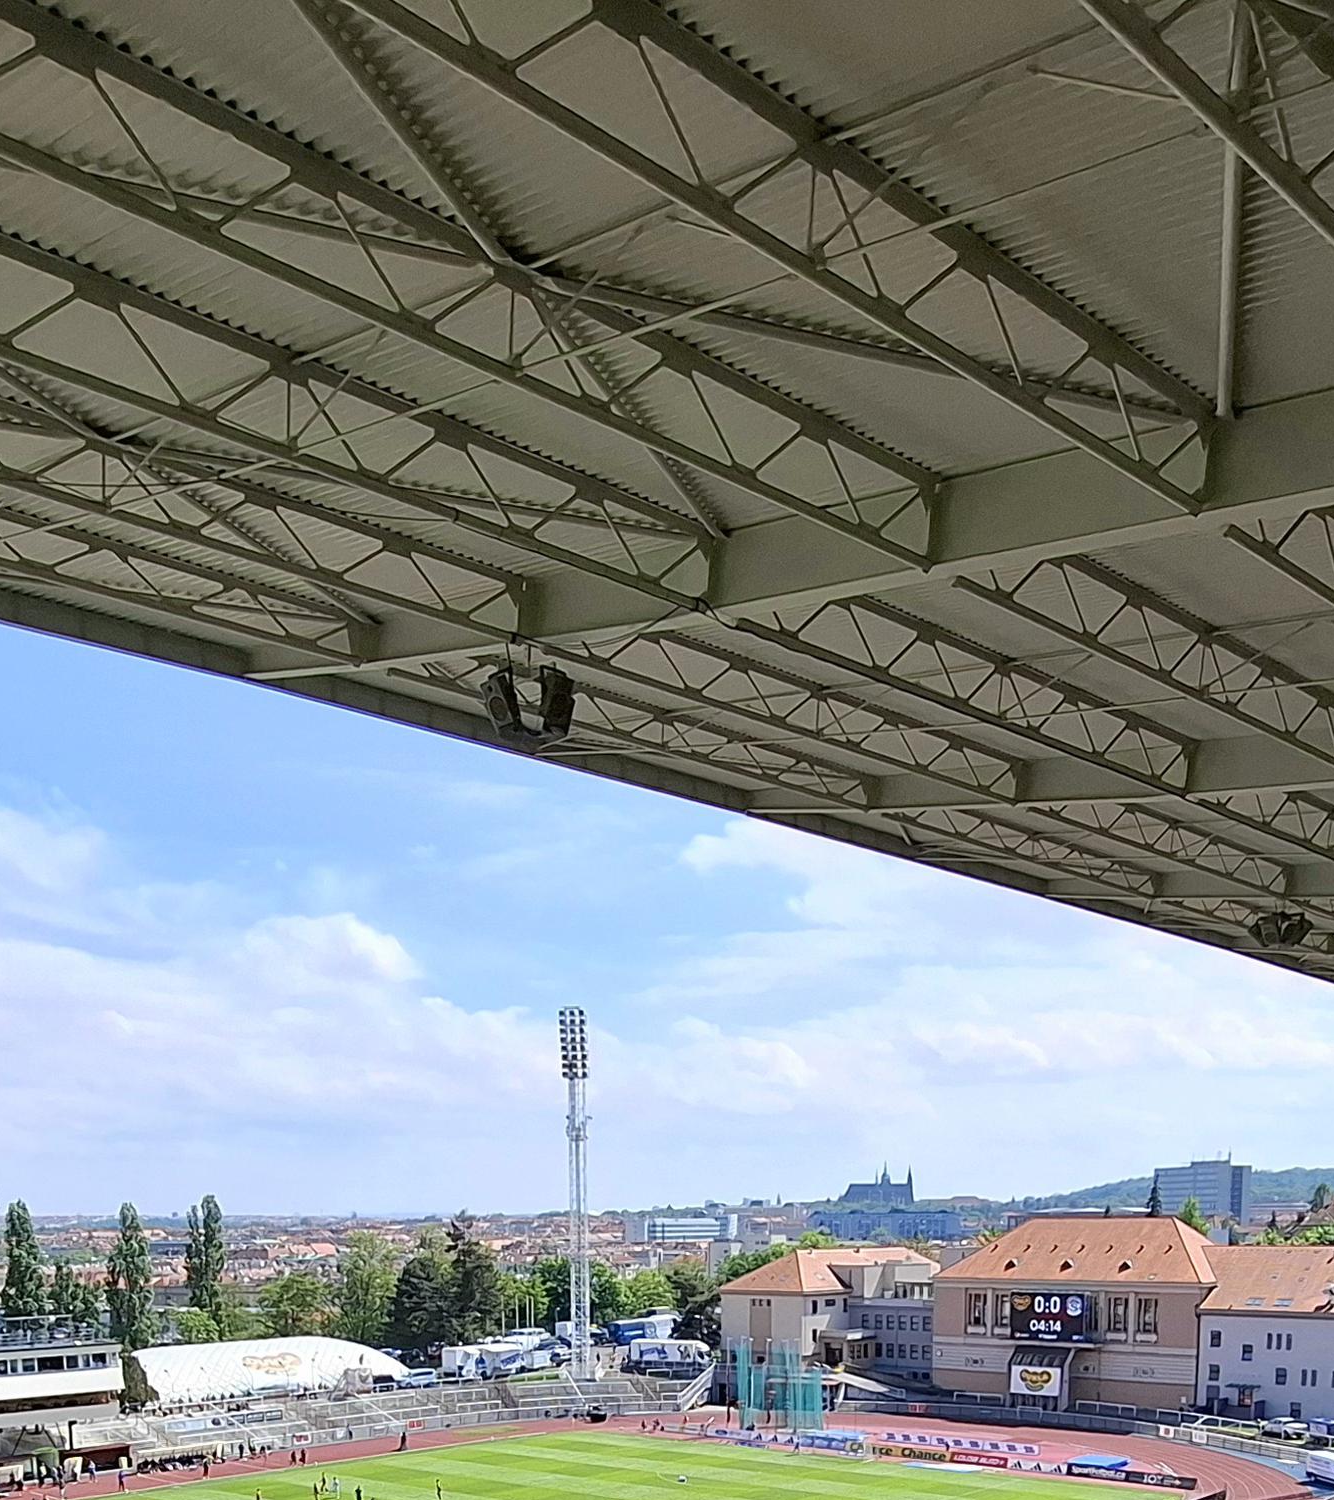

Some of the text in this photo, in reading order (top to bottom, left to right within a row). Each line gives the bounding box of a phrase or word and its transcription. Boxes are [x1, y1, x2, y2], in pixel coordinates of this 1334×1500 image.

[1033, 1295, 1061, 1314] 0:0
[1029, 1319, 1062, 1332] 04:14
[901, 1447, 947, 1462] Chance
